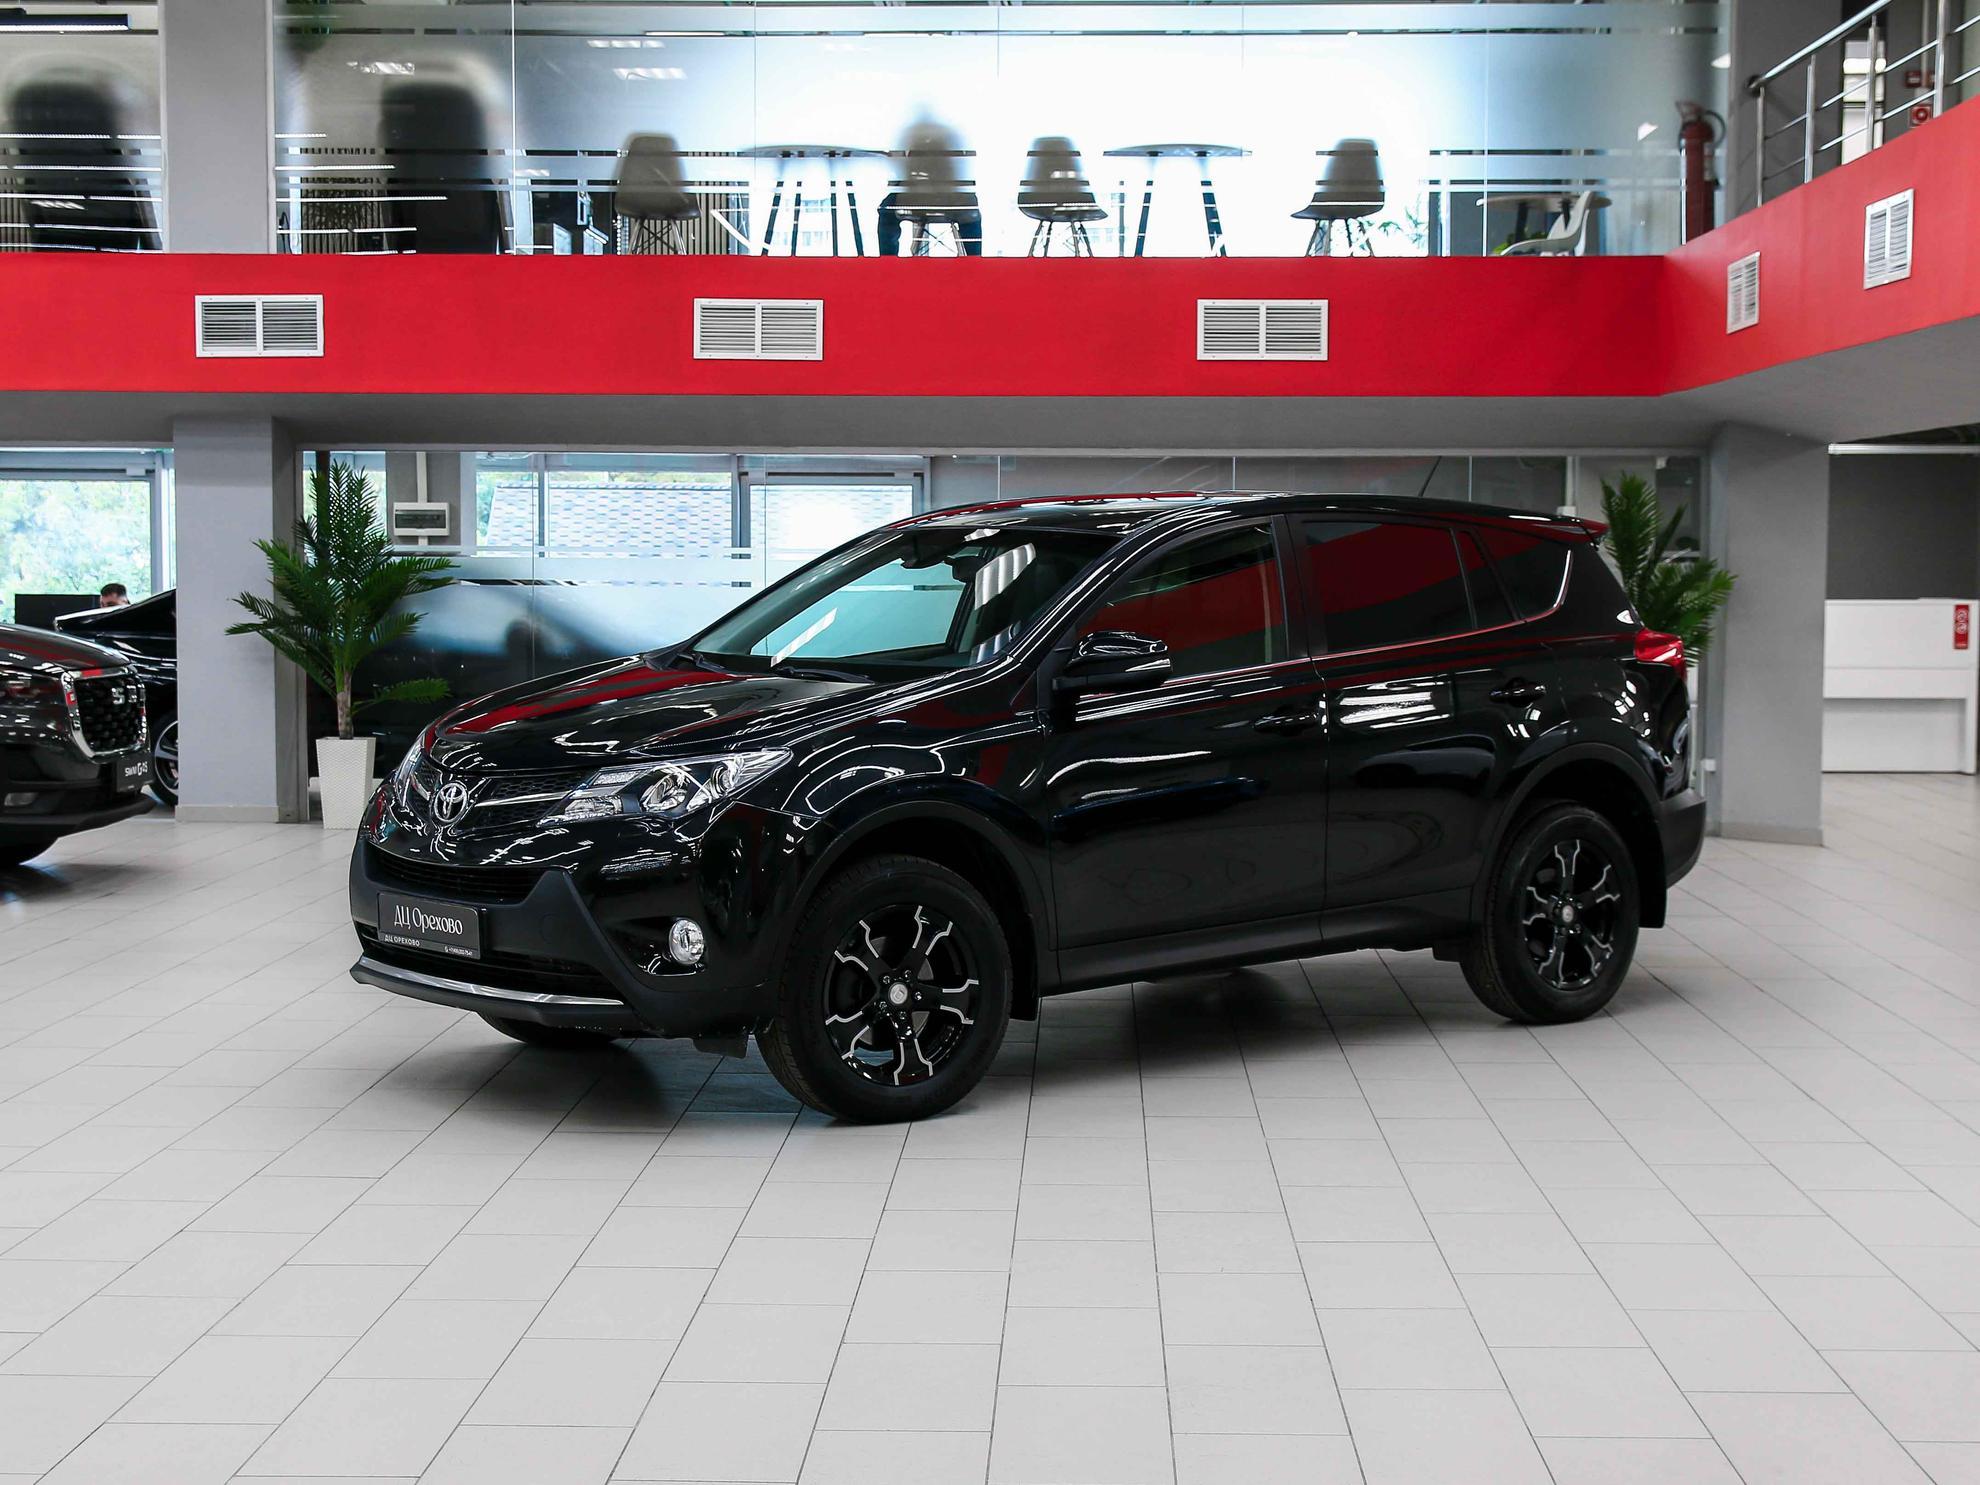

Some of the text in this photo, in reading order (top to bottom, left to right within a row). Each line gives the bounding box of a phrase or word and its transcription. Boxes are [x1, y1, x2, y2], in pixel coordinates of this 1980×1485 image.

[394, 904, 463, 935] ДЦ Орехово
[384, 934, 420, 947] ДЦ ОРЕХОВО
